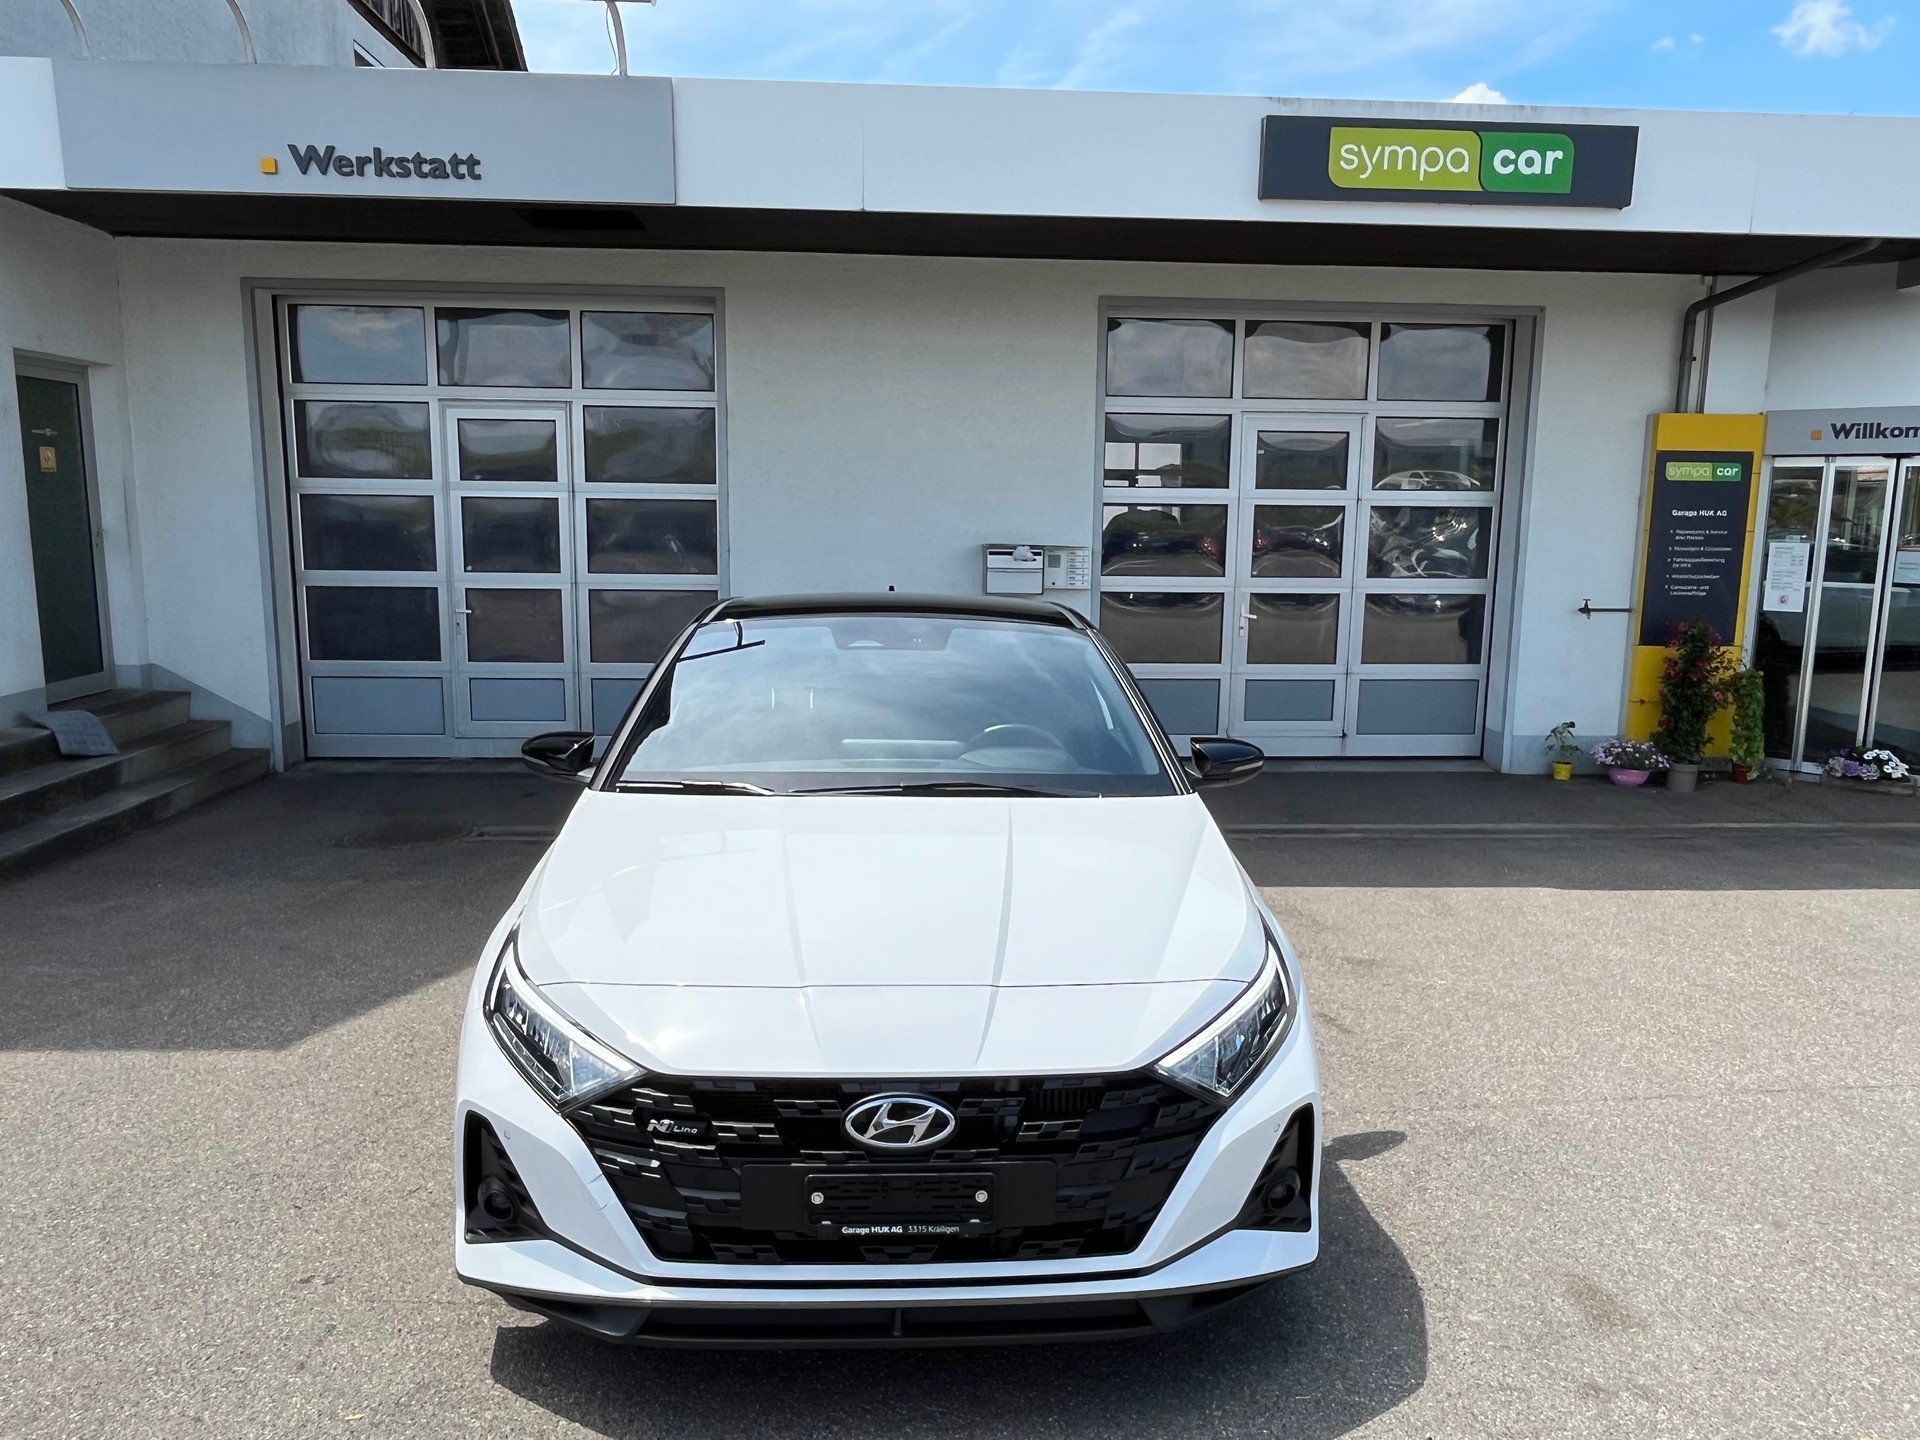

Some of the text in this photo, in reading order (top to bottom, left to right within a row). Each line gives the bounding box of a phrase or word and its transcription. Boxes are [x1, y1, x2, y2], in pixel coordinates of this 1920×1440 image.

[287, 144, 482, 180] Werkstatt
[1340, 143, 1563, 181] sympa car
[1668, 466, 1740, 479] sympa car
[1671, 509, 1698, 518] Garage
[1699, 509, 1715, 517] HUK
[673, 1126, 698, 1134] Line
[841, 1226, 870, 1236] Garage
[890, 1225, 903, 1234] AG
[908, 1225, 927, 1233] 3315
